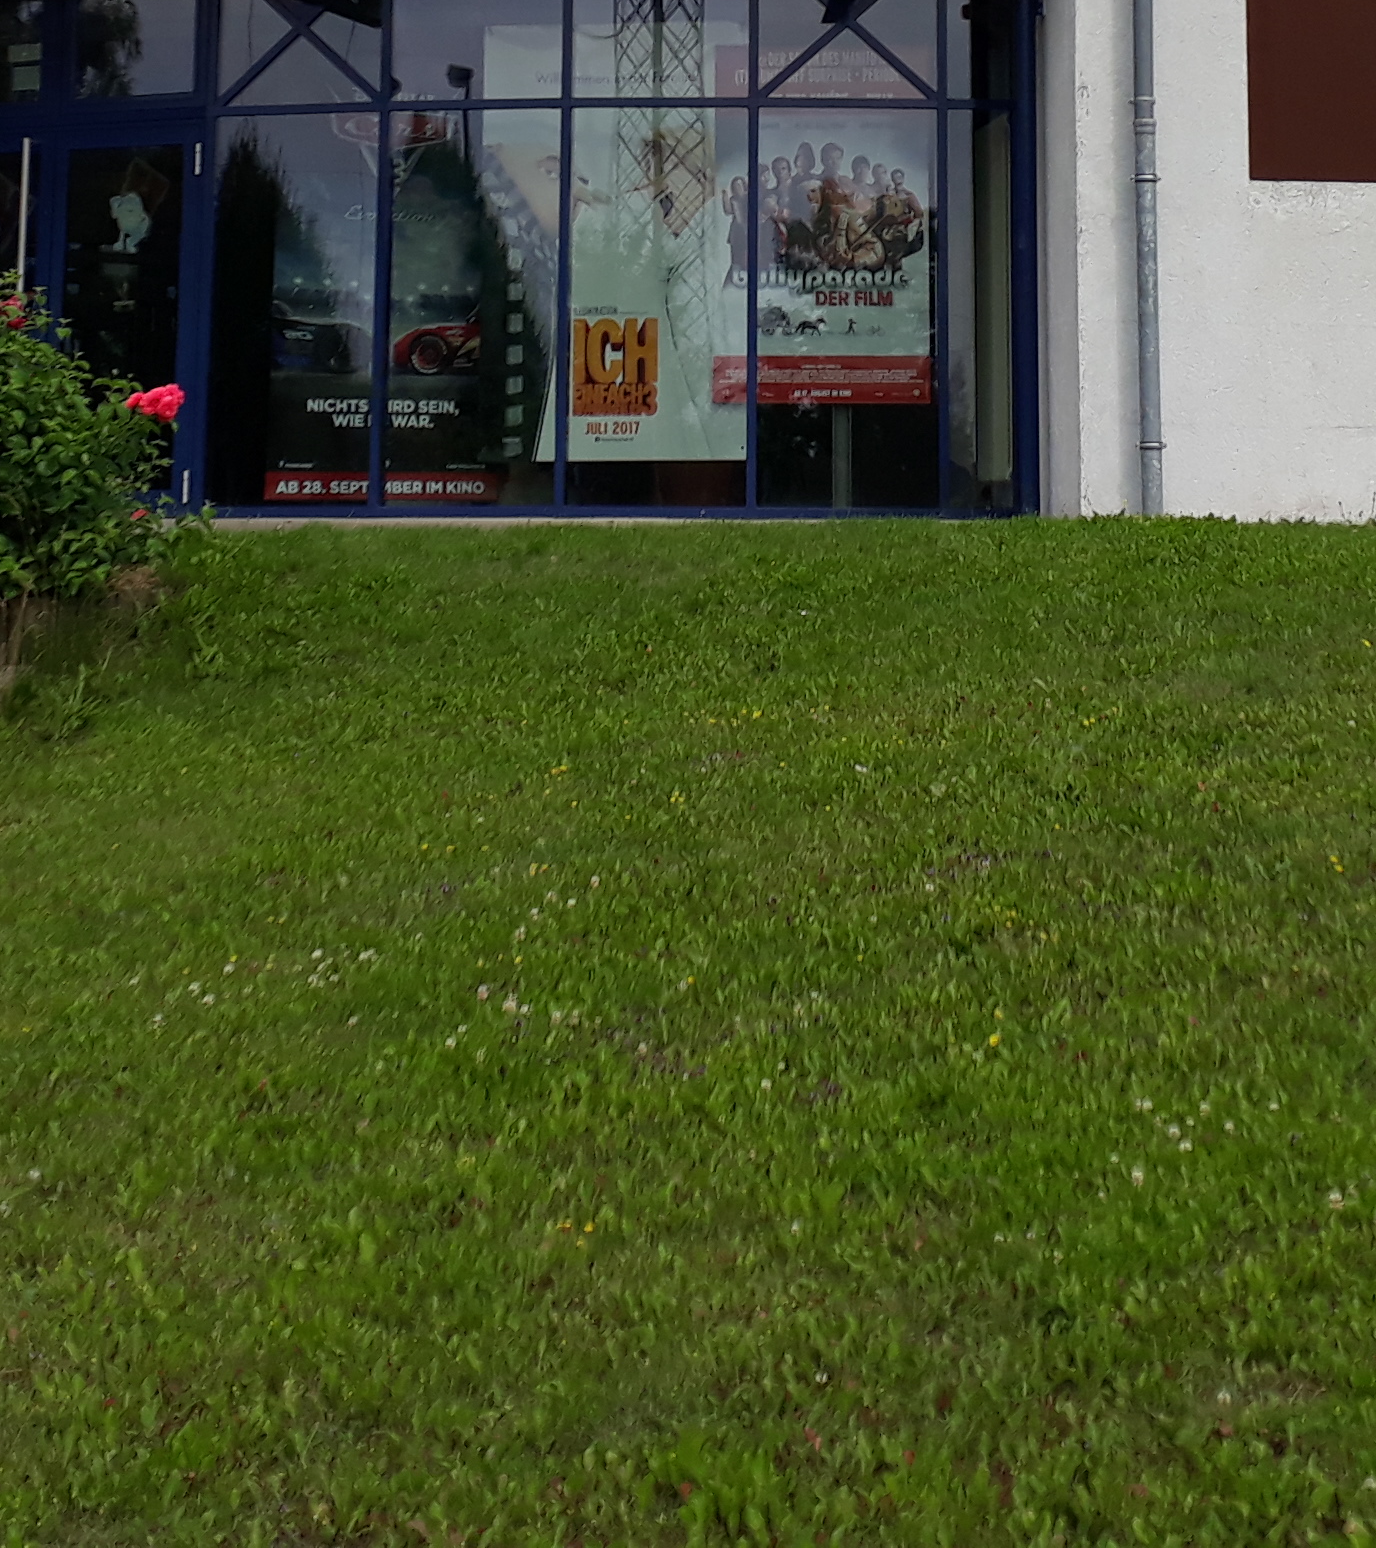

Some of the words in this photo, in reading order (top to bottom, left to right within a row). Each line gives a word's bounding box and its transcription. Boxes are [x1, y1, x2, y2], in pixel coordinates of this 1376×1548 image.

[815, 290, 852, 306] DER
[855, 291, 894, 307] FILM
[573, 318, 659, 385] ICH
[306, 399, 369, 413] NICHTS
[384, 399, 415, 413] IRD
[418, 399, 460, 416] SEIN,
[332, 414, 365, 427] WIE
[391, 414, 435, 428] WAR.
[585, 421, 609, 435] JULI
[612, 421, 640, 435] 2017
[276, 480, 299, 494] AB
[303, 480, 327, 494] 28.
[426, 481, 442, 494] IM
[446, 481, 485, 494] KINO
